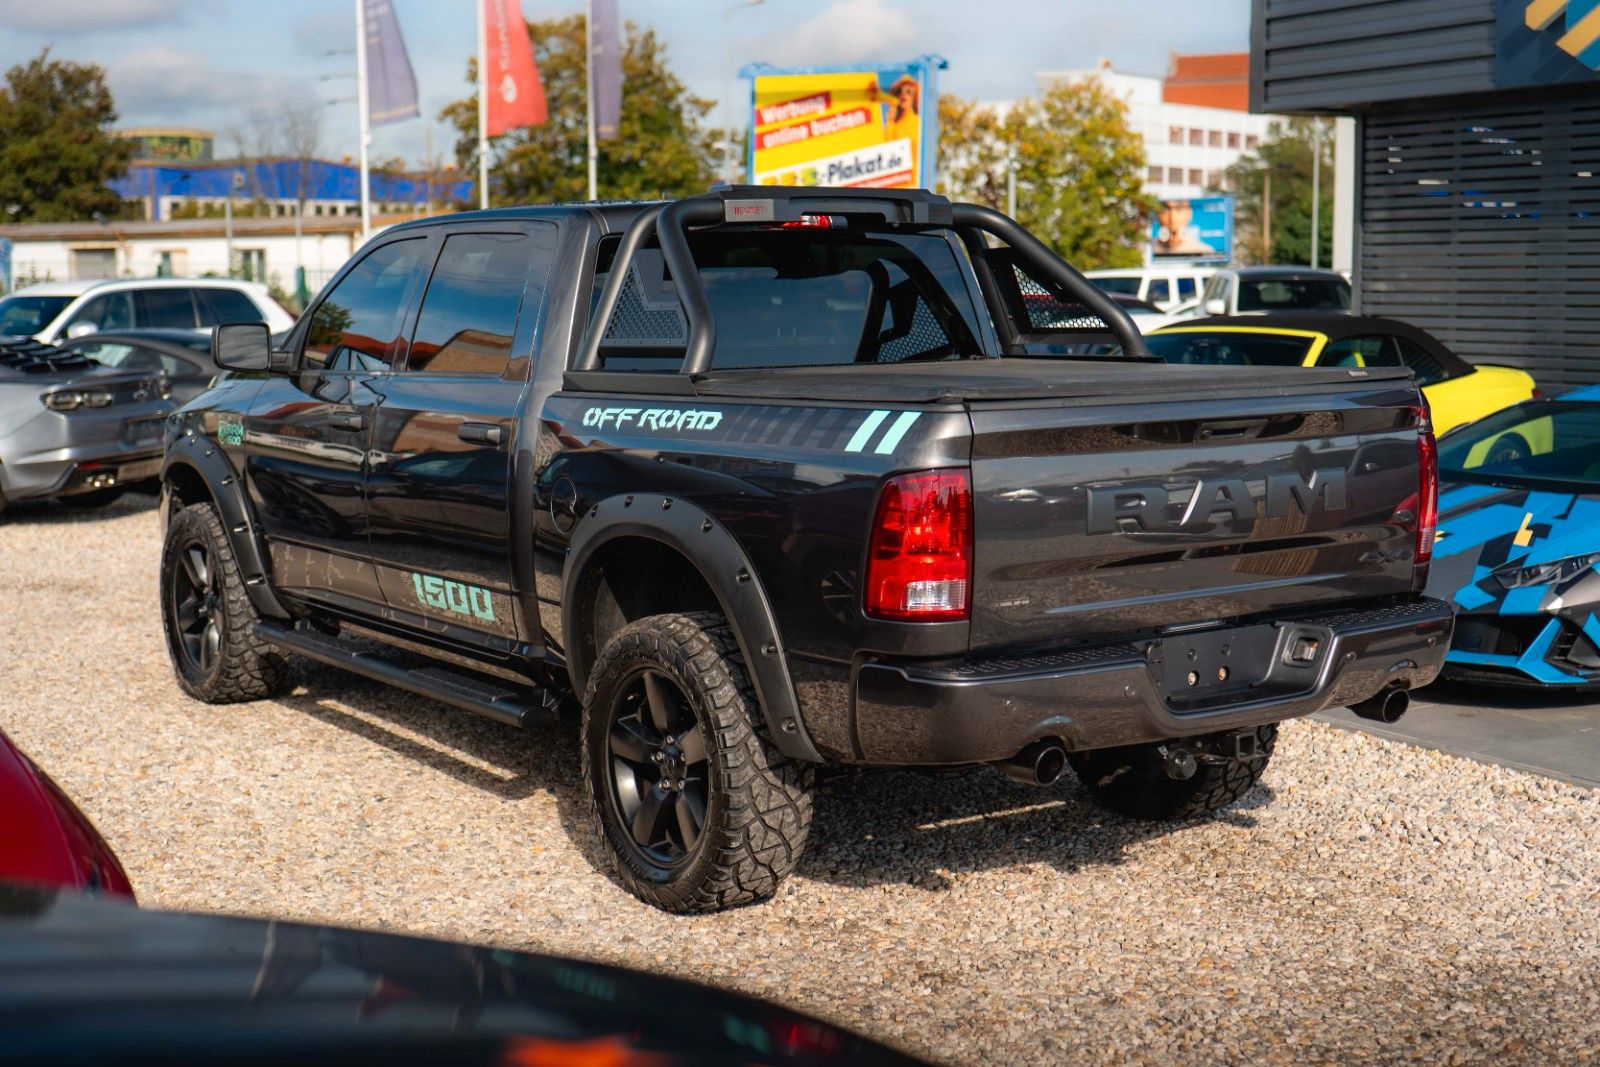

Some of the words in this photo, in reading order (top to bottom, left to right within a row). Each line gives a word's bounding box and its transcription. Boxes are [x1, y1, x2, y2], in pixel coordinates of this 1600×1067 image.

[760, 95, 827, 124] Werbung
[763, 124, 810, 148] online
[810, 109, 867, 136] buchen
[582, 407, 643, 432] OFF
[638, 408, 723, 434] ROAD
[1086, 467, 1347, 535] RAM
[413, 573, 495, 621] 1500
